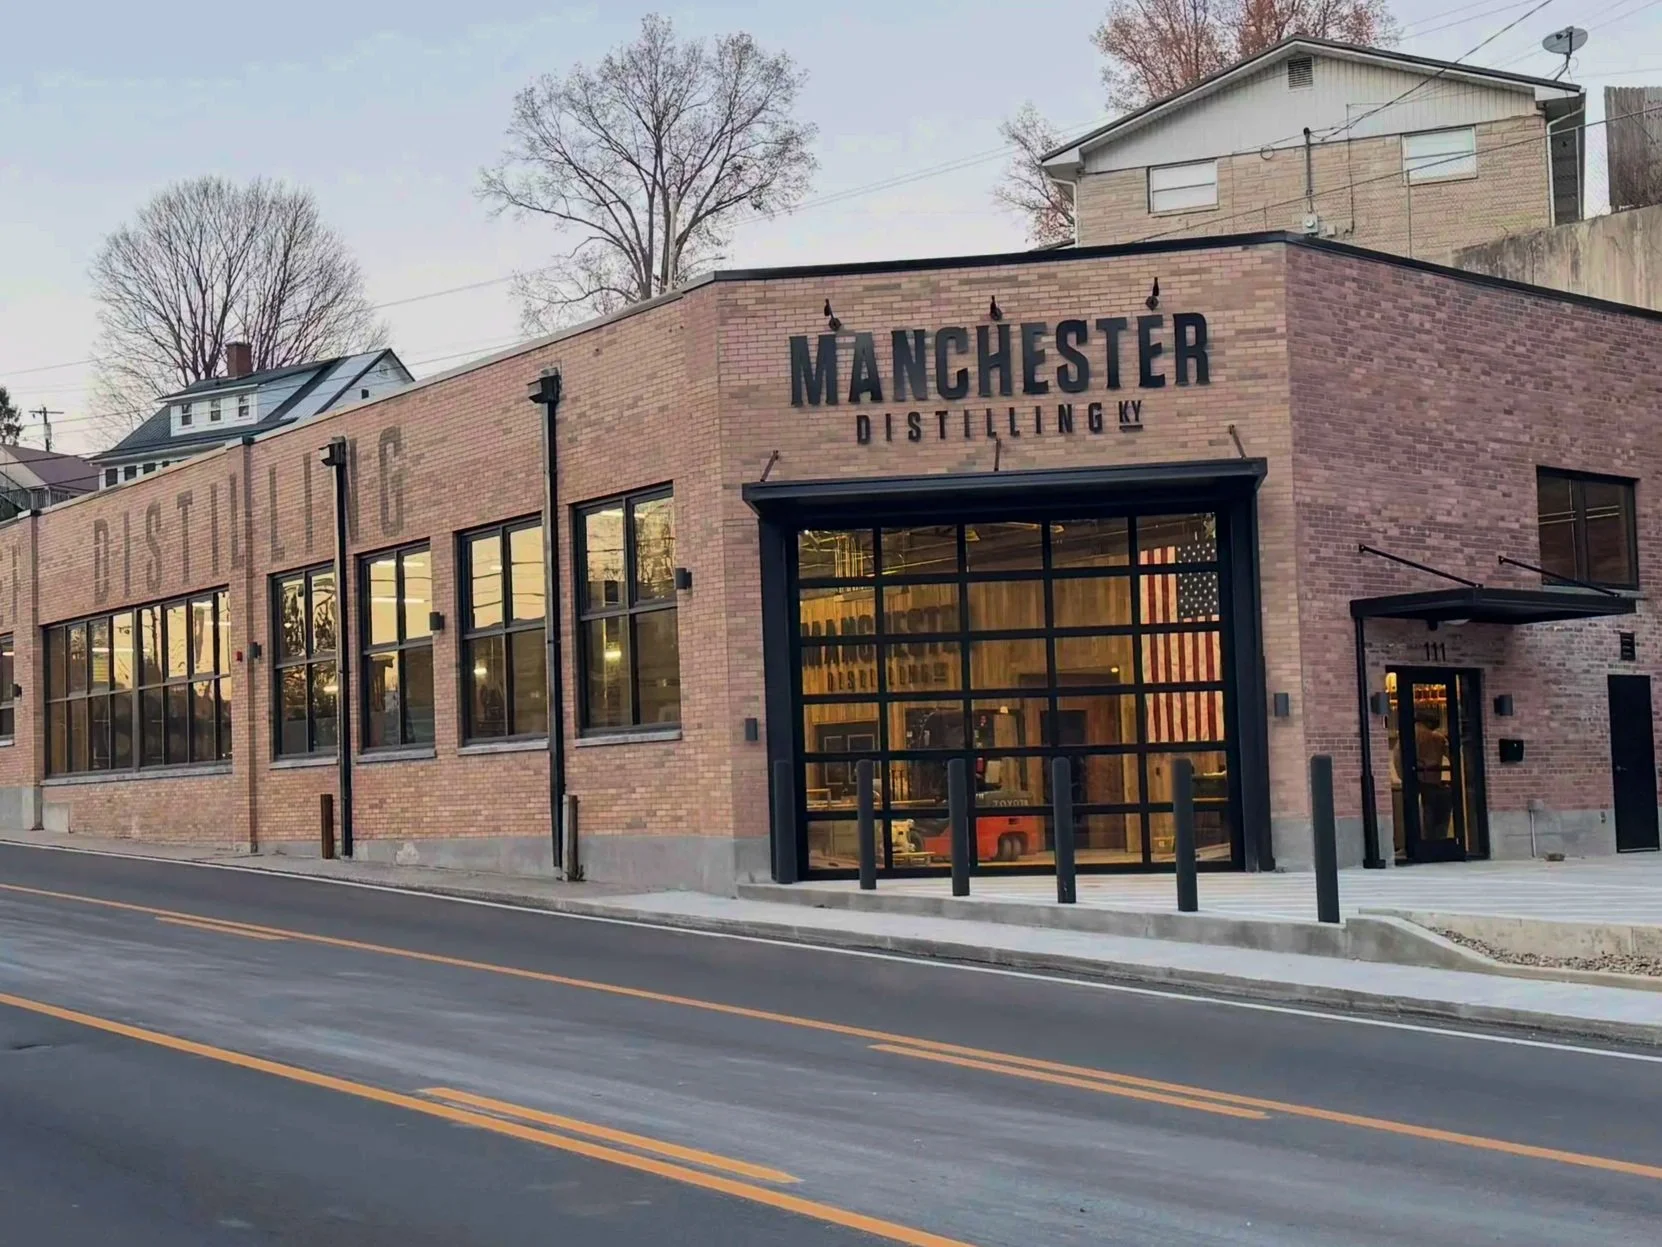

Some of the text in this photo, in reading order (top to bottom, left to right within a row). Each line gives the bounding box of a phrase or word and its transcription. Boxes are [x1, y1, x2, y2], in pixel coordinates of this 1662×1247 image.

[789, 312, 1211, 406] MANCHESTER
[856, 400, 1143, 445] DISTILLING KY
[1424, 641, 1446, 662] 111
